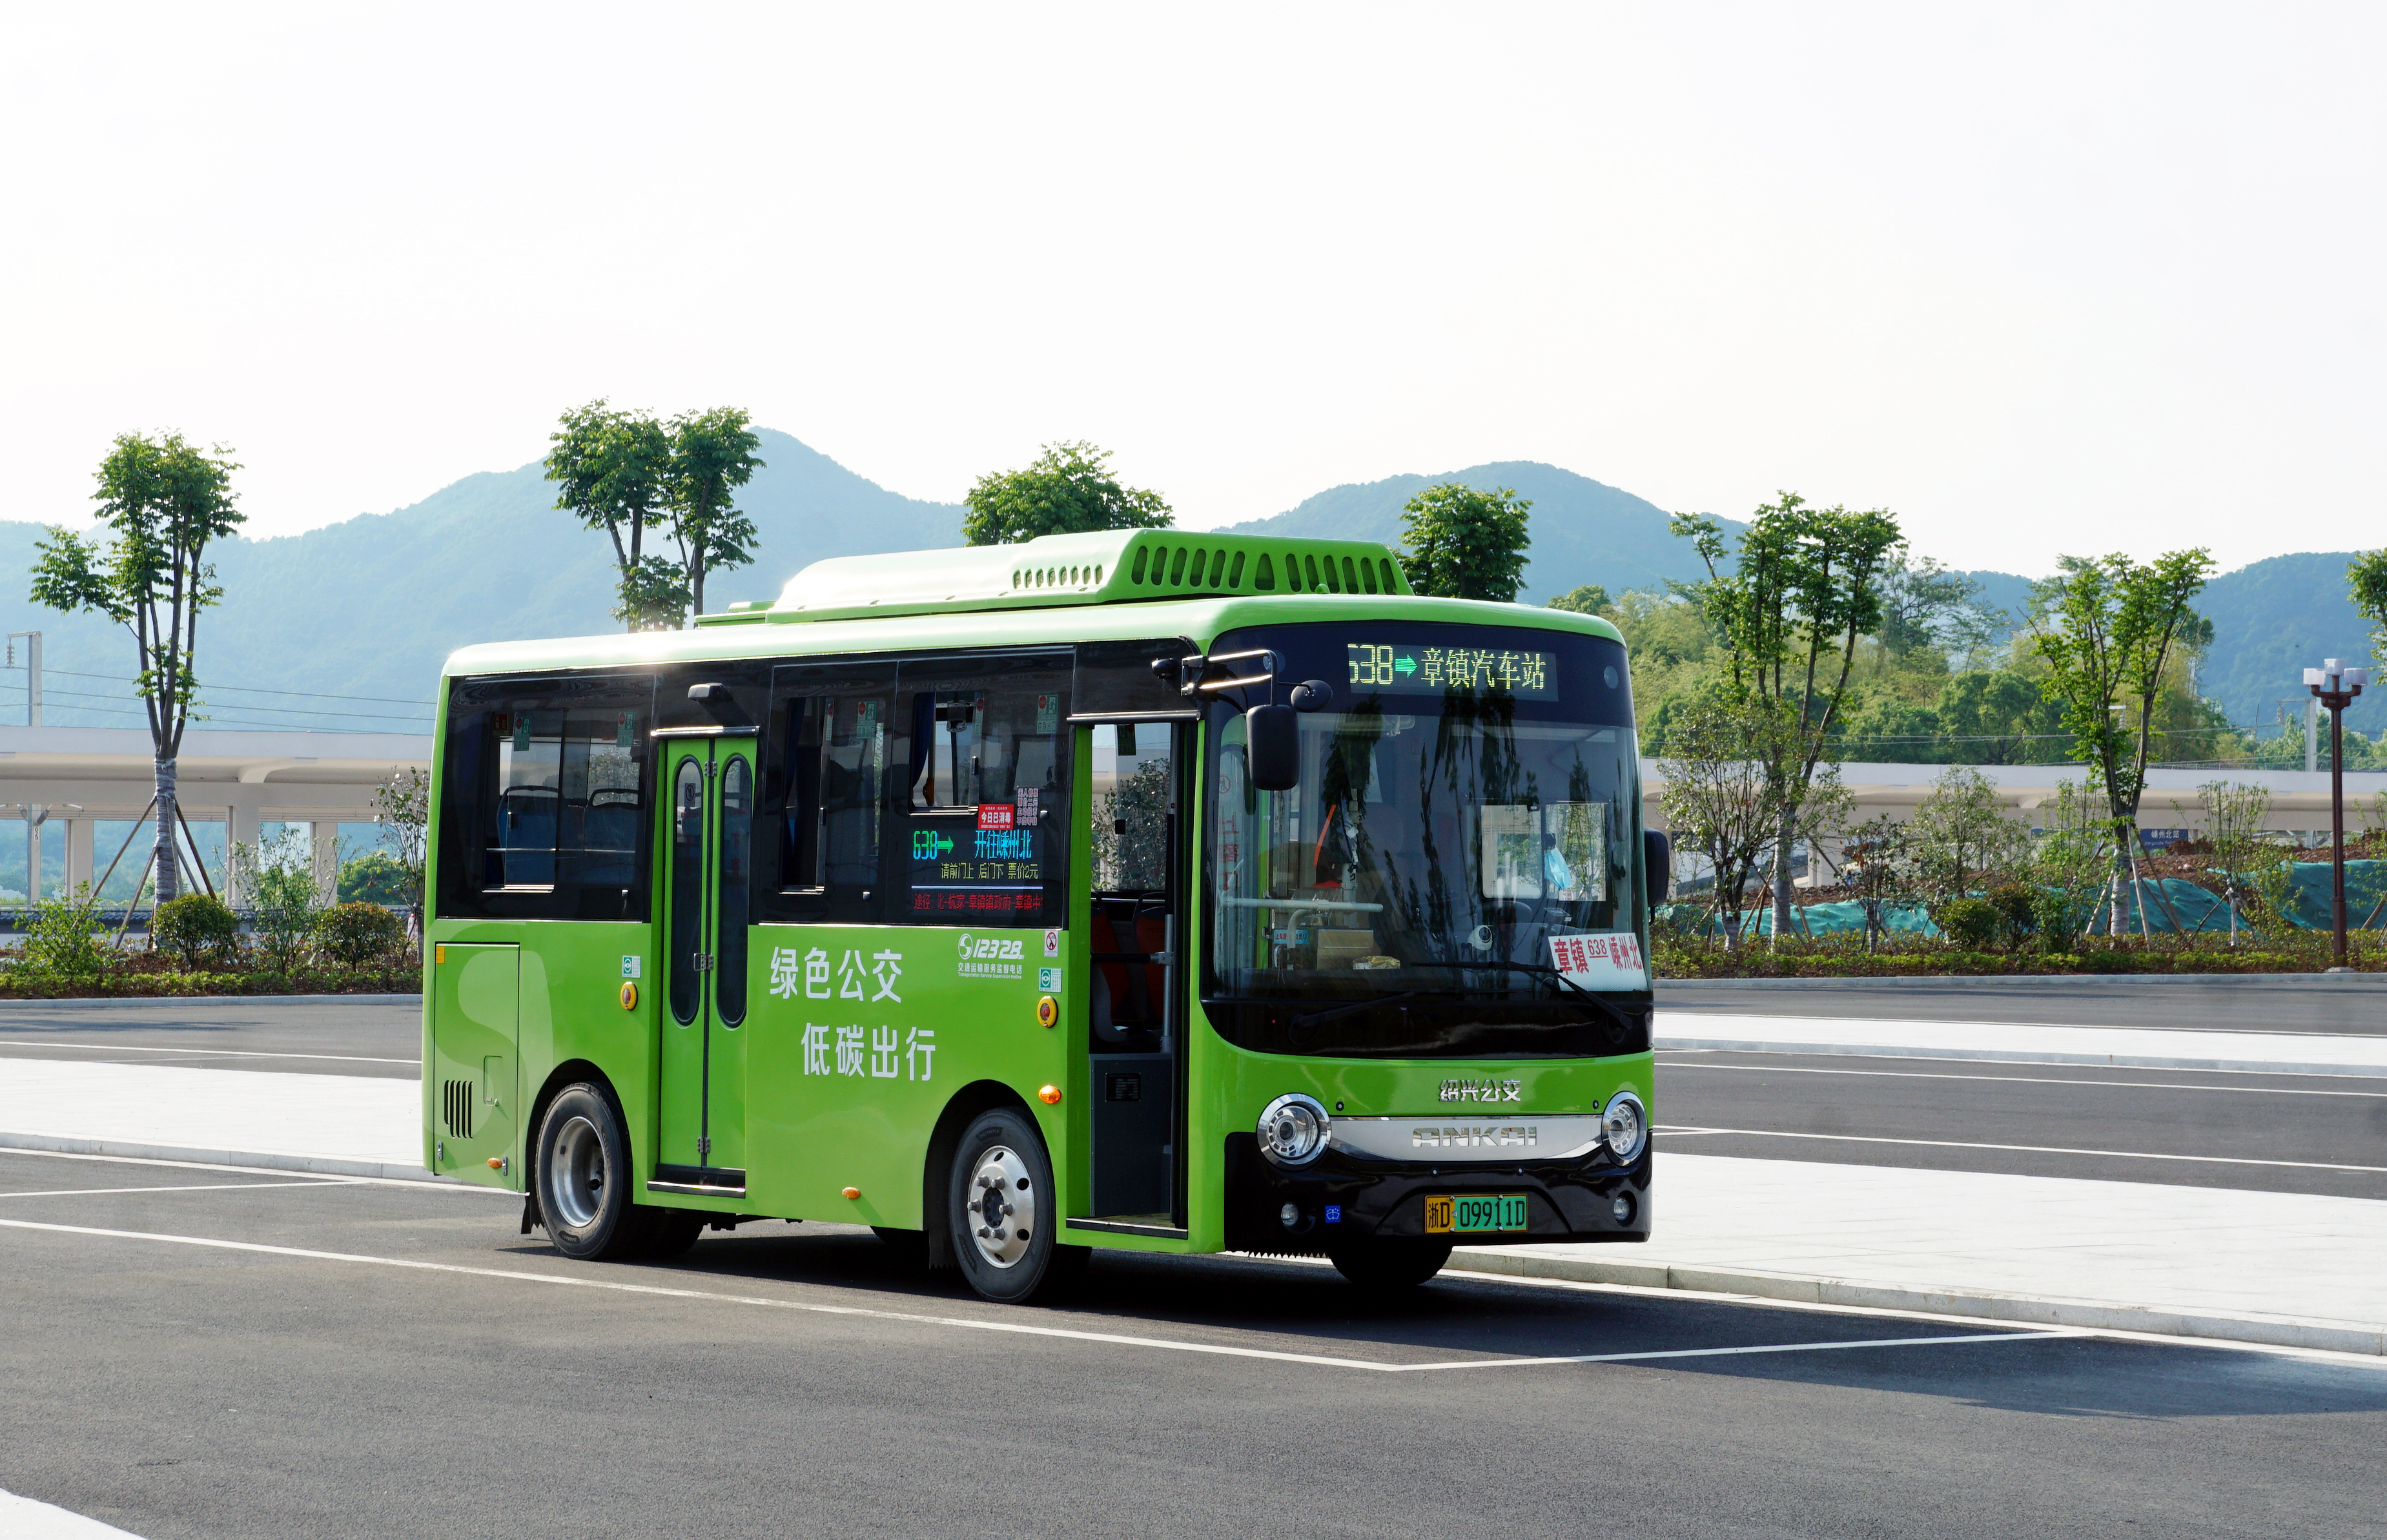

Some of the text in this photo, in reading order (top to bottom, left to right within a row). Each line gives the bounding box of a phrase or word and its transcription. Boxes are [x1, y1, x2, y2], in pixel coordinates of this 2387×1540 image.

[1420, 647, 1547, 690] 章镇汽车站
[981, 811, 1011, 824] 今日已消毒
[913, 829, 1032, 859] 638 开往嵊州北
[2151, 830, 2180, 839] 嵊州北站
[941, 862, 1038, 879] 请前门上 后门下 票价2元
[972, 939, 1023, 960] 12328
[1553, 936, 1643, 976] 章镇 638 嵊州北
[770, 946, 903, 1003] 绿色公交
[958, 962, 1023, 974] 交通运输服务监督电话
[801, 1022, 936, 1082] 低碳出行
[1439, 1079, 1522, 1102] 绍兴公交
[1412, 1126, 1537, 1147] ANKAI
[1459, 1200, 1526, 1227] 09911D
